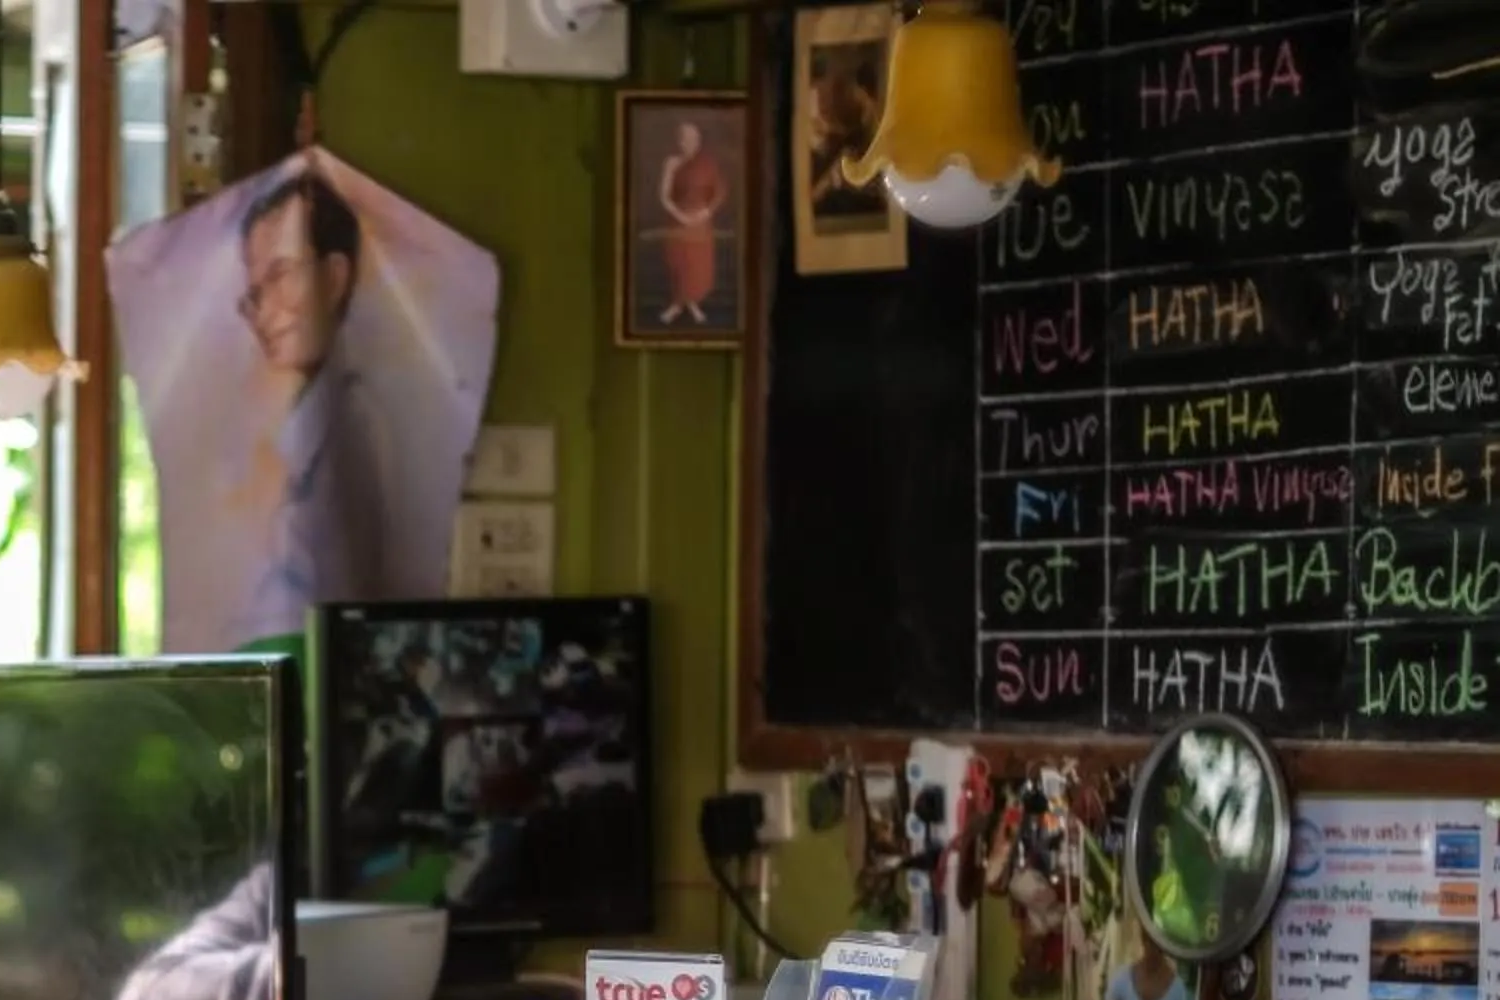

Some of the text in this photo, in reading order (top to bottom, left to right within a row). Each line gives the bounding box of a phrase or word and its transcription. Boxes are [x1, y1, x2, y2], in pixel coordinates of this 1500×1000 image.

[1140, 40, 1302, 128] HATHA
[994, 278, 1094, 374] Wed
[1128, 279, 1265, 350] HATHA
[990, 408, 1099, 475] Thur
[1143, 391, 1280, 455] HATHA
[1014, 481, 1080, 537] Fri
[1127, 459, 1240, 516] HATHA
[1149, 540, 1340, 617] HATHA
[997, 642, 1084, 702] Sun
[1134, 637, 1285, 711] HATHA
[1355, 629, 1488, 717] Inside
